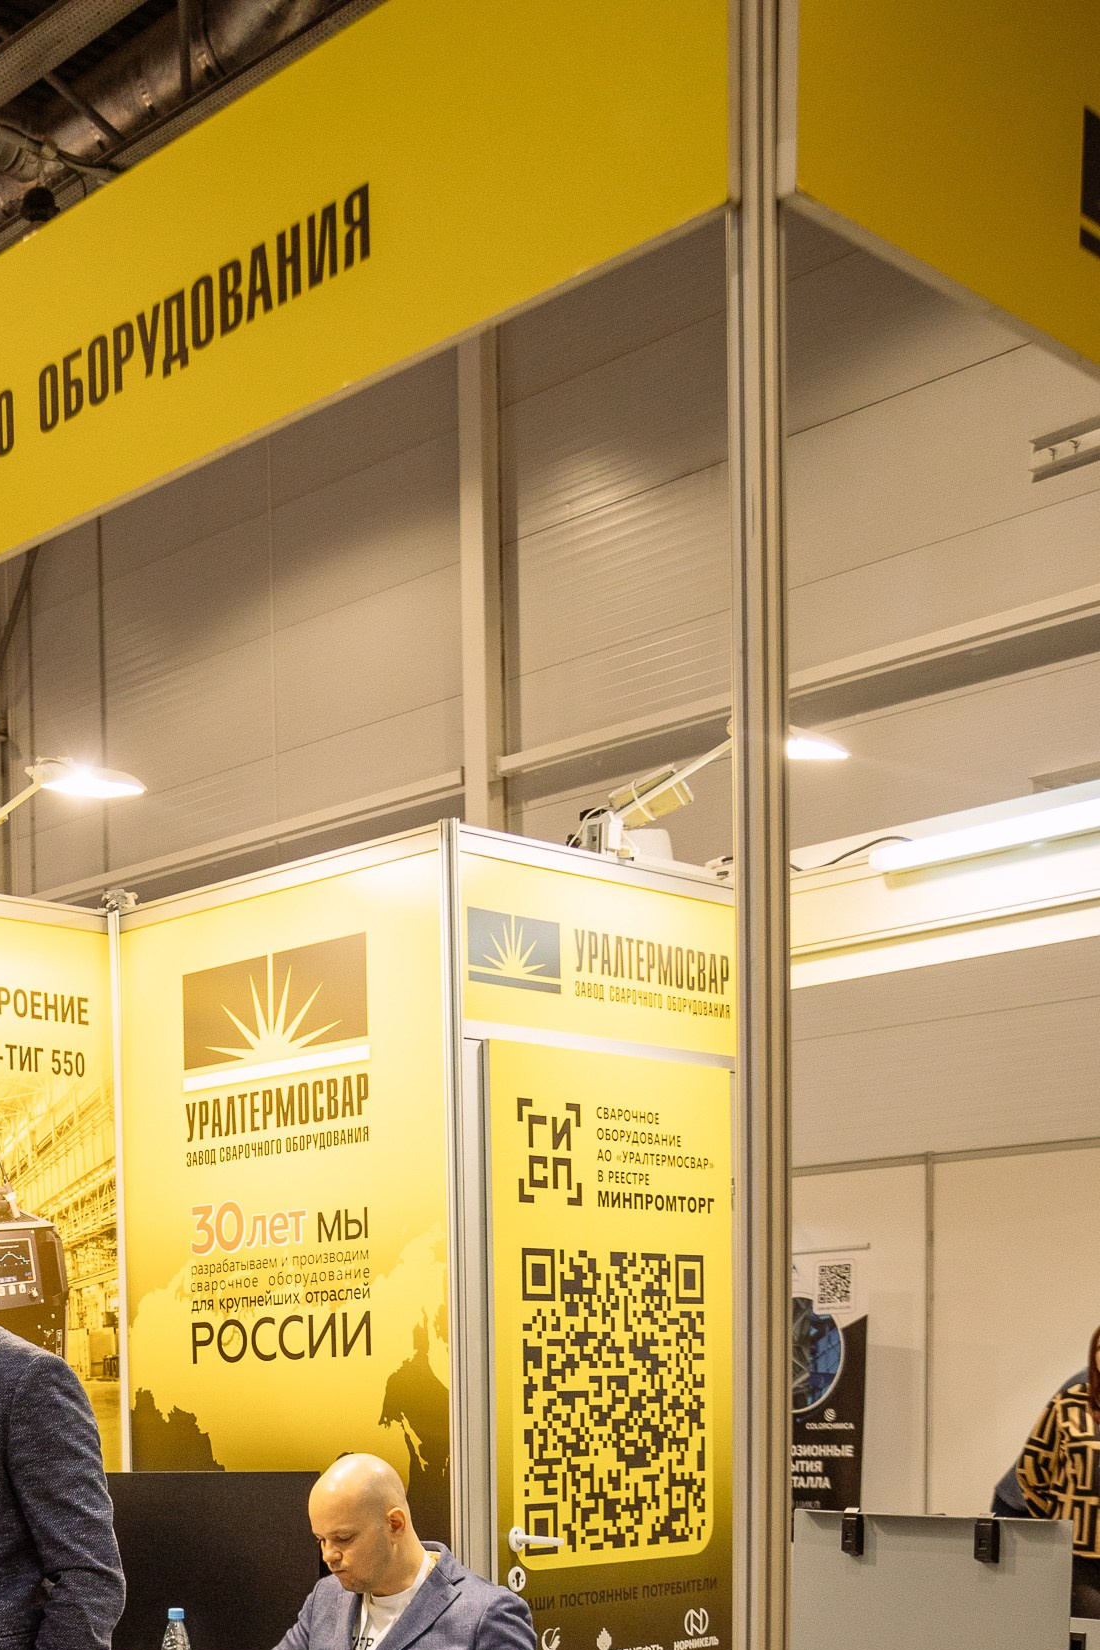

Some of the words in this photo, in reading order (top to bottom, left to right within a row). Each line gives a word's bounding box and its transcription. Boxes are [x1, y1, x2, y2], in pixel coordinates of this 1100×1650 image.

[39, 182, 372, 434] ОБОРУДОВАНИЯ
[575, 928, 729, 995] УРАЛТЕРМОСВАР
[575, 980, 604, 1002] ЗАВОД
[609, 985, 663, 1009] СВАРОЧНОГО
[667, 992, 731, 1019] ОБОРУДОВАНИЯ
[51, 1051, 85, 1078] 550
[186, 1073, 369, 1142] УРАЛТЕРМОСВАР
[597, 1106, 660, 1125] СВАРОЧНОЕ
[186, 1148, 216, 1167] ЗАВОД
[219, 1138, 281, 1162] СВАРОЧНОГО
[285, 1126, 369, 1153] ОБОРУДОВАНИЯ
[597, 1127, 681, 1147] ОБОРУДОВАНИЕ
[597, 1149, 612, 1162] АО
[597, 1170, 604, 1182] В
[609, 1171, 650, 1185] РЕЕСТРЕ
[597, 1191, 715, 1214] МИНПРОМТОРГ
[318, 1207, 368, 1242] МЫ
[191, 1257, 277, 1277] разрабатываем
[281, 1258, 288, 1268] и
[292, 1250, 369, 1268] производим
[191, 1275, 258, 1292] сварочное
[269, 1268, 369, 1287] оборудование
[192, 1299, 214, 1313] для
[219, 1291, 300, 1313] крупнейших
[306, 1283, 370, 1307] отраслей
[192, 1311, 371, 1364] РОССИИ
[791, 1445, 854, 1457] ОЗИОННЫЕ
[792, 1476, 831, 1489] ТАЛЛА
[528, 1597, 556, 1611] АШИ
[560, 1586, 638, 1607] ПОСТОЯННЫЕ
[642, 1577, 717, 1598] ПОТРЕБИТЕЛИ
